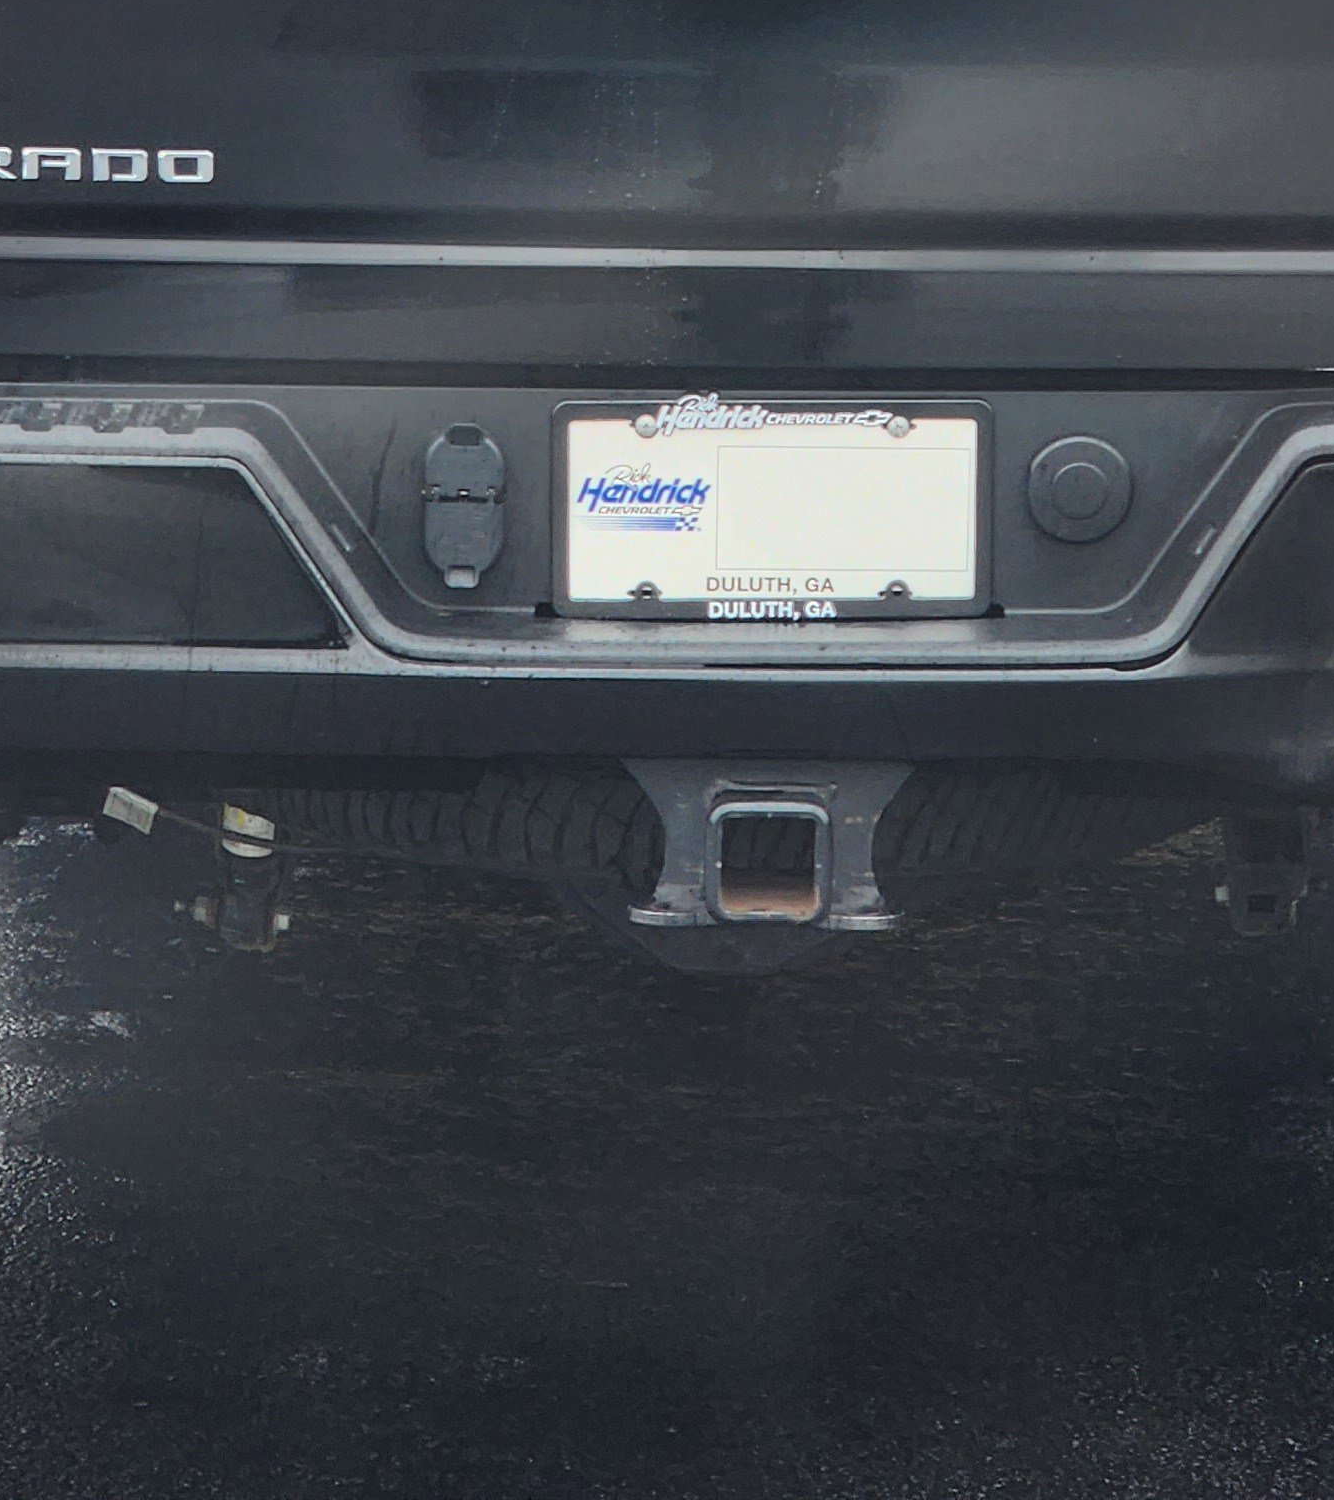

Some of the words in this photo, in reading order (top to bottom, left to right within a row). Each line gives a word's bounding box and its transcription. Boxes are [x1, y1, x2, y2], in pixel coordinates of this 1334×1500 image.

[656, 404, 769, 436] Hendrick
[768, 412, 856, 425] CHEVROLET
[605, 462, 652, 486] Rick
[576, 477, 711, 513] Hendrick
[598, 506, 673, 514] CHEVROLET
[706, 576, 797, 594] DULUTH,
[805, 577, 835, 592] GA
[708, 601, 801, 621] DULUTH,
[804, 601, 837, 619] GA
